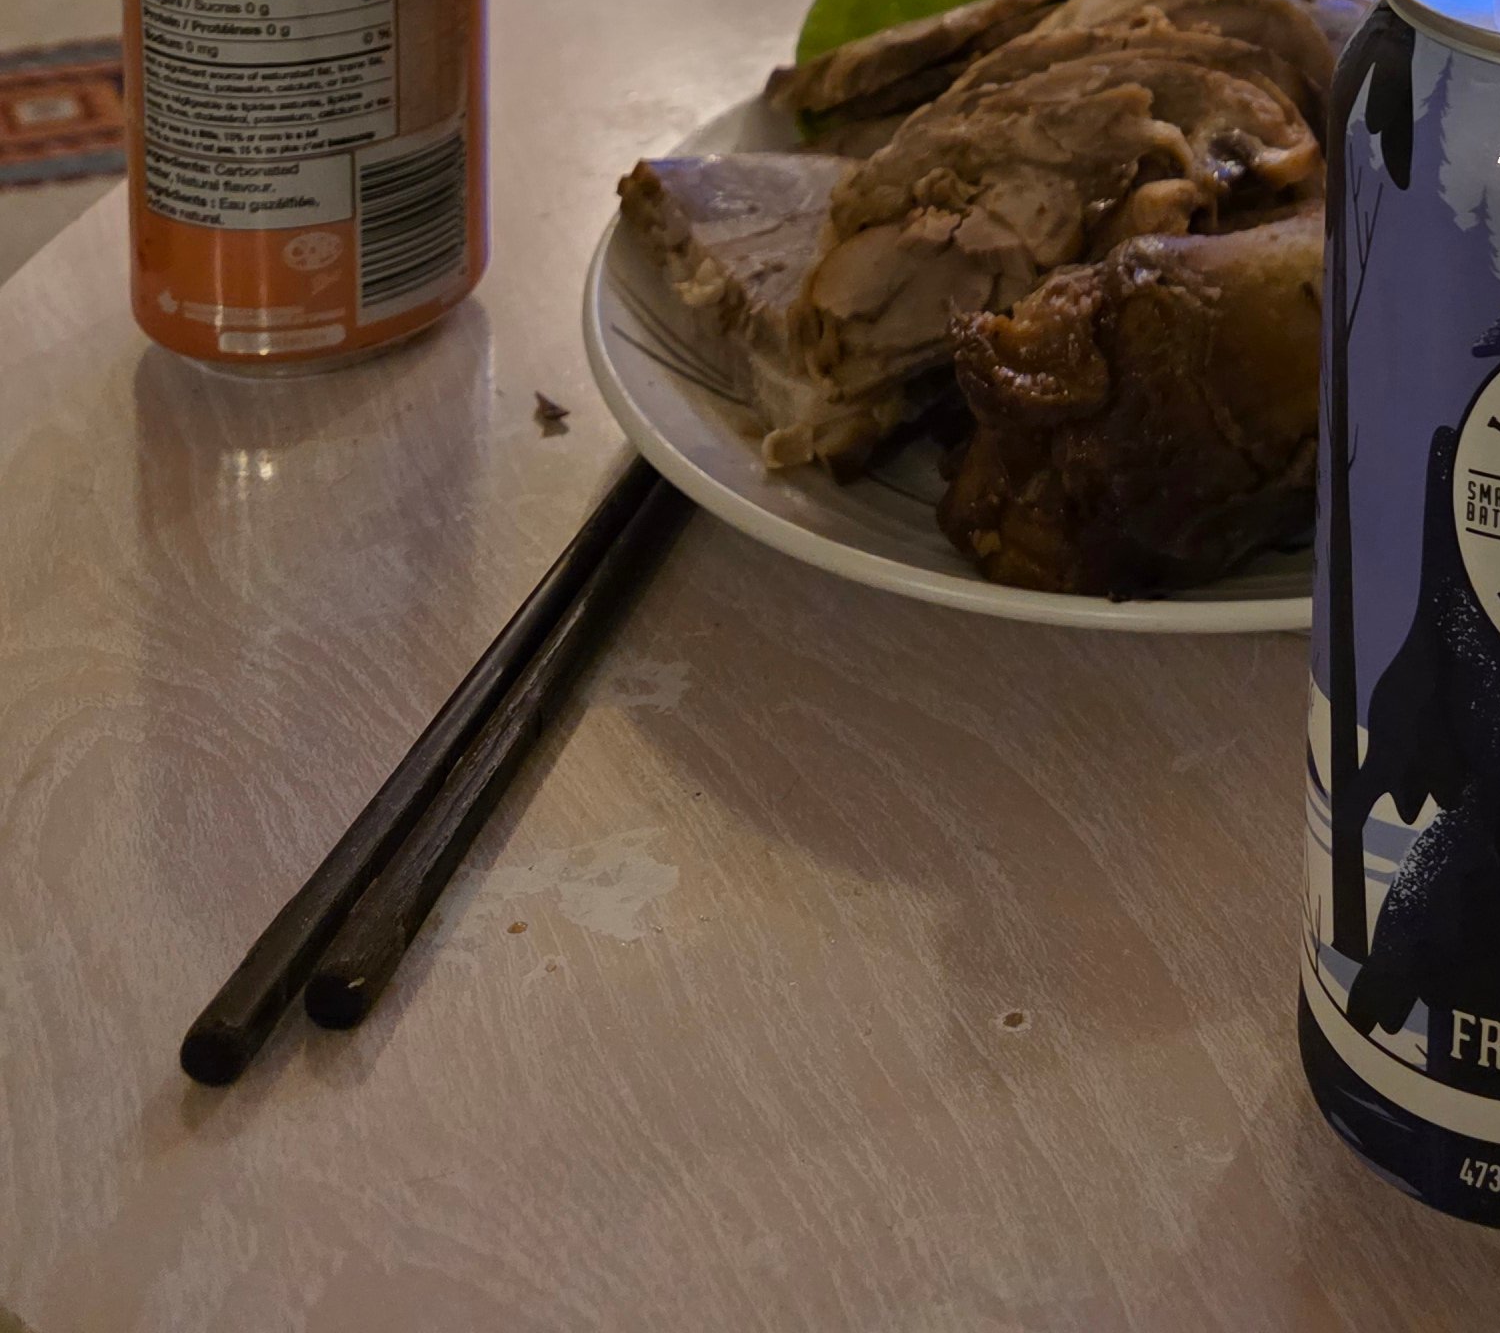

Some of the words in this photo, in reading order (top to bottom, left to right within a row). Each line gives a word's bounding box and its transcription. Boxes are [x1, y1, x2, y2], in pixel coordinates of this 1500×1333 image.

[245, 1, 256, 14] 0
[266, 24, 277, 36] 0
[214, 162, 300, 177] Carbonated
